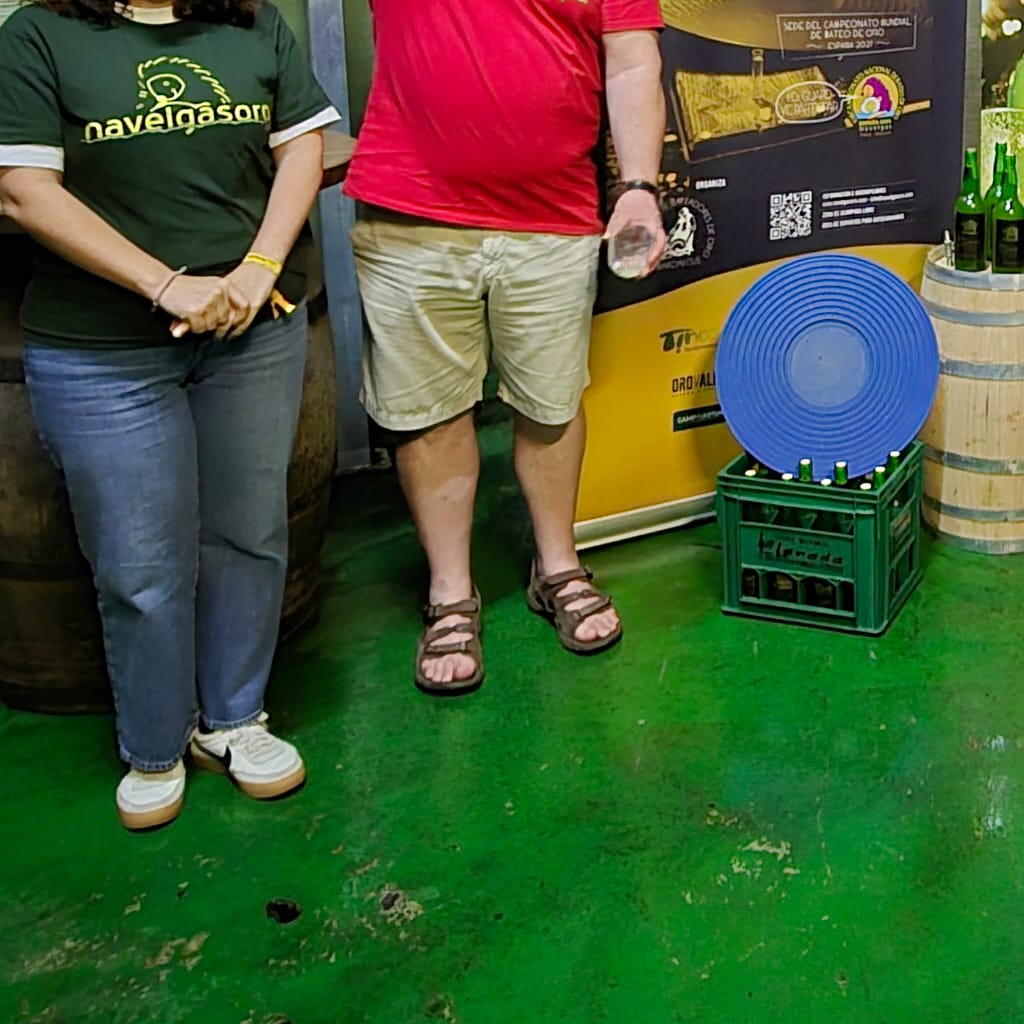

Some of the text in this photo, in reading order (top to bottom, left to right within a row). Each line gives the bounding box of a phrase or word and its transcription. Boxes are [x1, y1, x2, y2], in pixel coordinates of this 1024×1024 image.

[806, 20, 822, 30] DEL
[823, 18, 880, 29] CAMPEONATO
[810, 28, 885, 40] DE BATEO DE ORO
